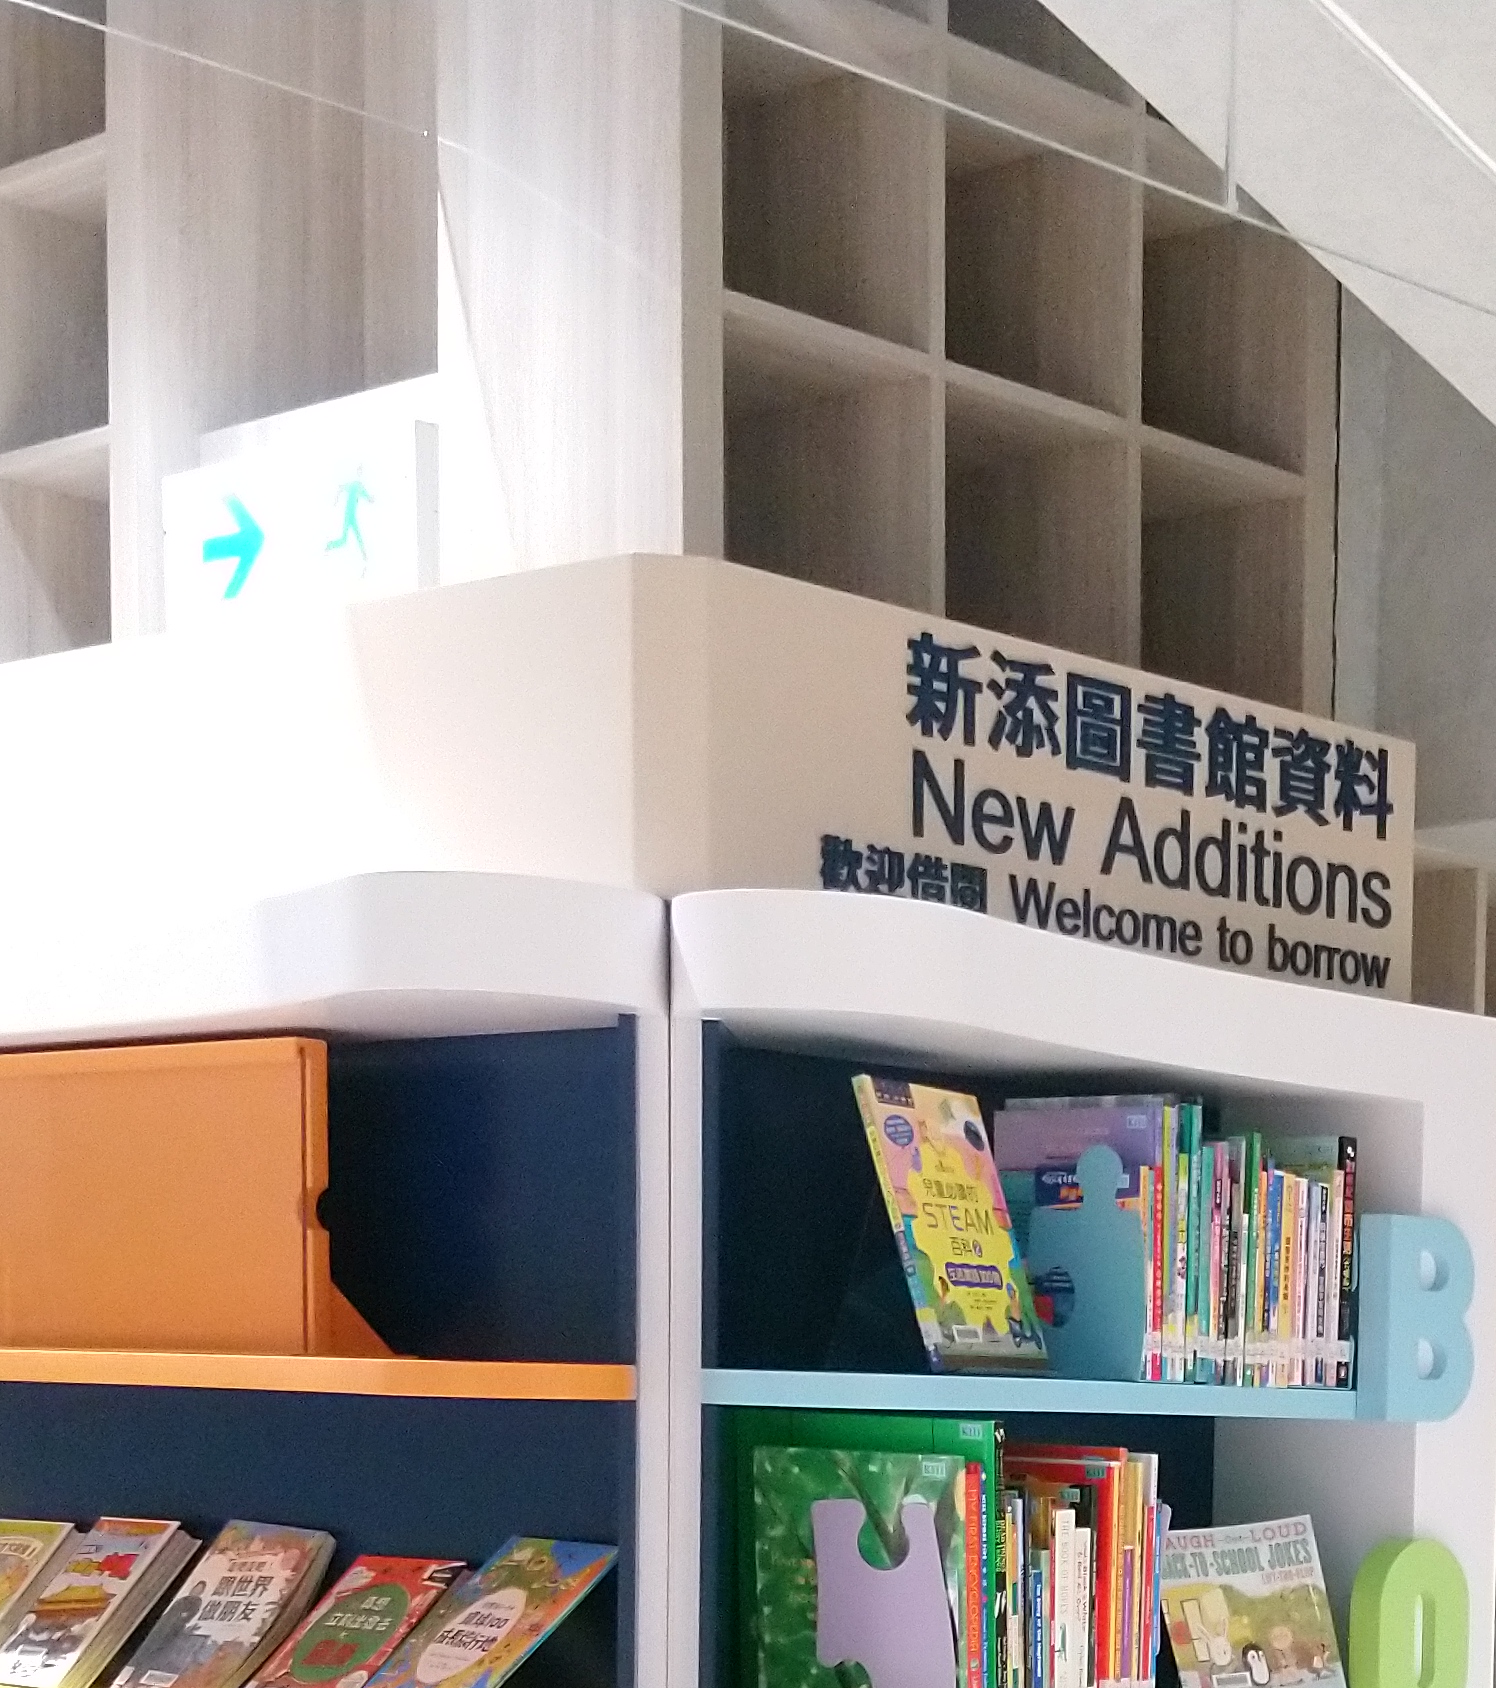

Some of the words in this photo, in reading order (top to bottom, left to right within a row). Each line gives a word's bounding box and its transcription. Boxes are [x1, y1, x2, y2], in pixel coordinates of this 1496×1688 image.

[906, 632, 1394, 840] 新添圖書館資料
[912, 749, 1075, 866] New
[1099, 797, 1393, 929] Additions
[1008, 873, 1202, 957] Welcome
[1217, 916, 1253, 966] to
[1267, 924, 1391, 989] borrow
[921, 1203, 994, 1236] STEAM
[967, 1488, 979, 1510] MY
[967, 1515, 979, 1549] FIRST
[1060, 1520, 1070, 1537] THE
[1163, 1534, 1215, 1551] AUGH
[1249, 1521, 1308, 1543] LOUD
[1060, 1542, 1070, 1565] BOOK
[1162, 1545, 1265, 1580] ACK-TO-SCHOOL
[1267, 1538, 1313, 1571] JOKES
[1060, 1569, 1070, 1581] OF
[1060, 1586, 1070, 1615] HOPES
